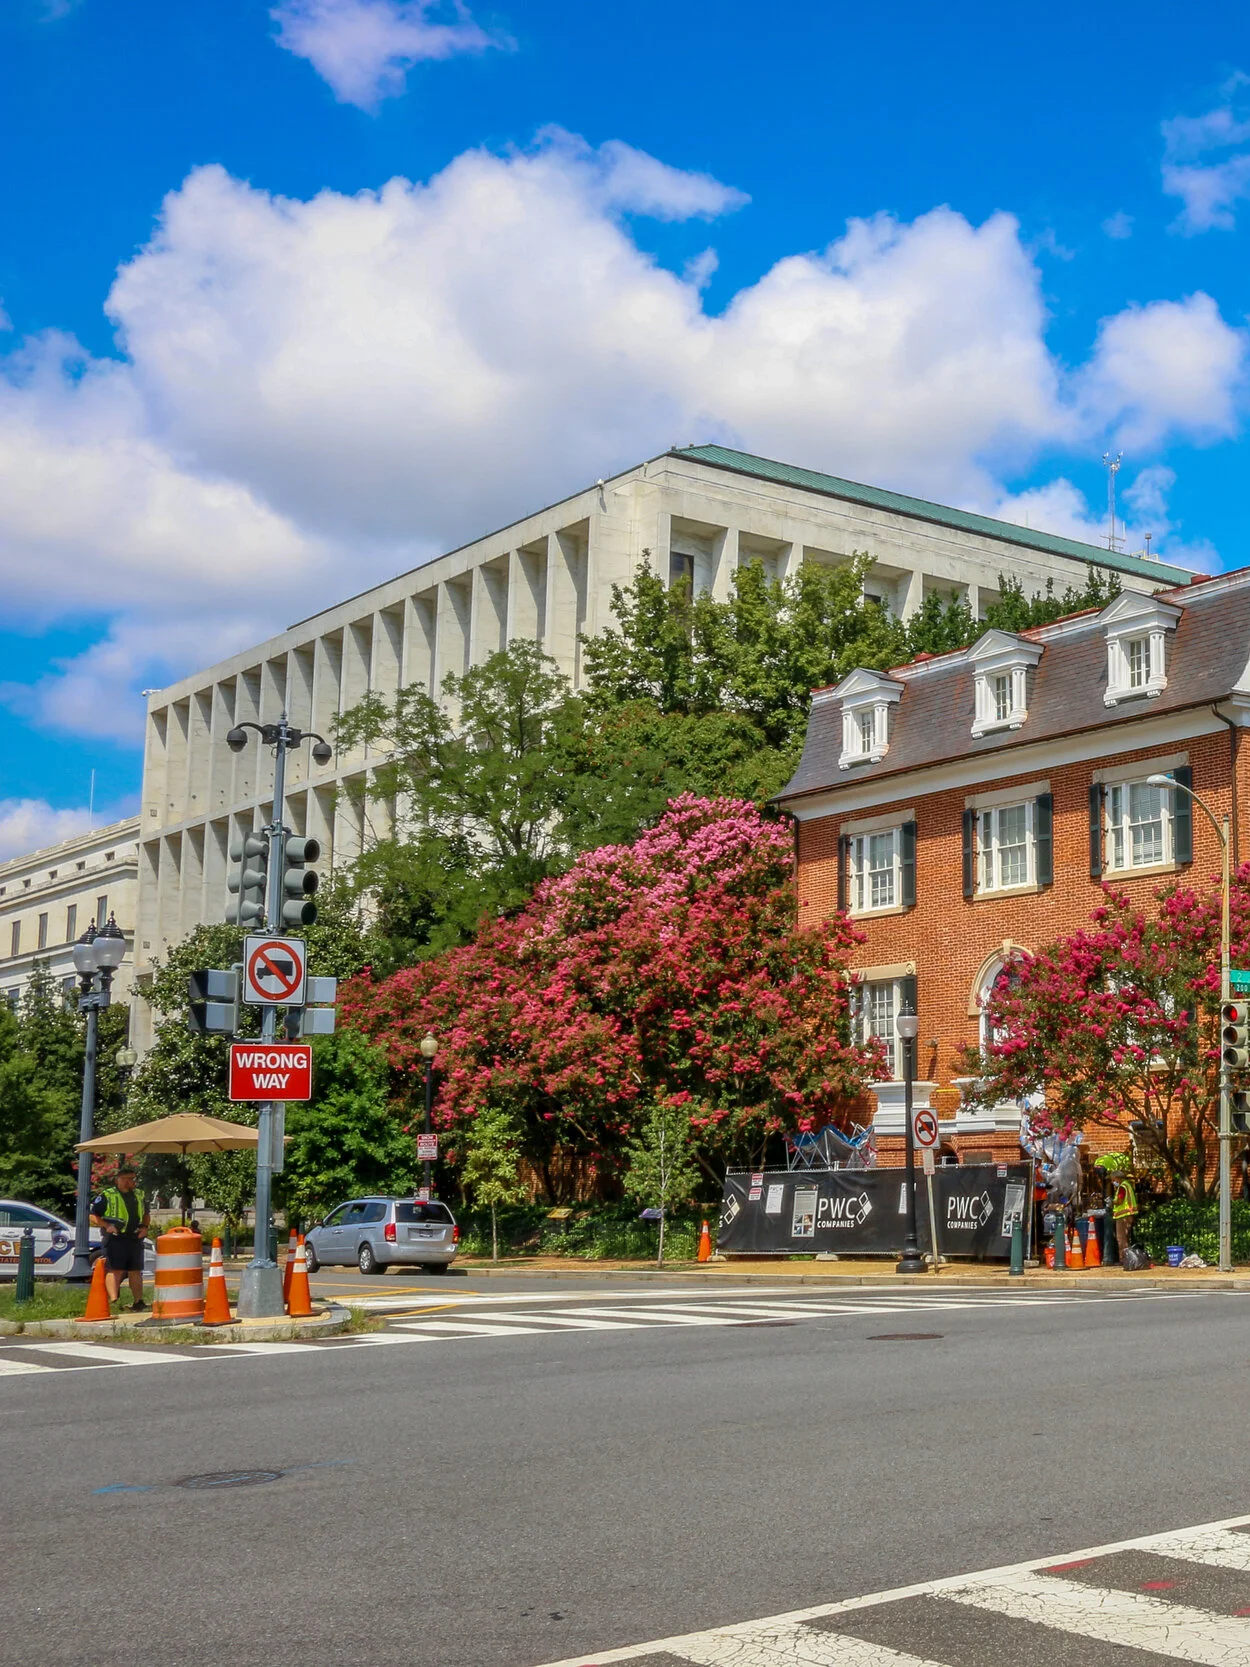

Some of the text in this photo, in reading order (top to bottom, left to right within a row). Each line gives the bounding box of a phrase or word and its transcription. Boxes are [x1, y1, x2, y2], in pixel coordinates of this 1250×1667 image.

[1236, 984, 1248, 992] 200
[236, 1053, 308, 1069] WRONG
[252, 1073, 290, 1089] WAY
[817, 1197, 857, 1219] PWC
[947, 1196, 979, 1219] PWC
[817, 1219, 855, 1228] COMPANIES
[946, 1221, 977, 1230] COMPANIES
